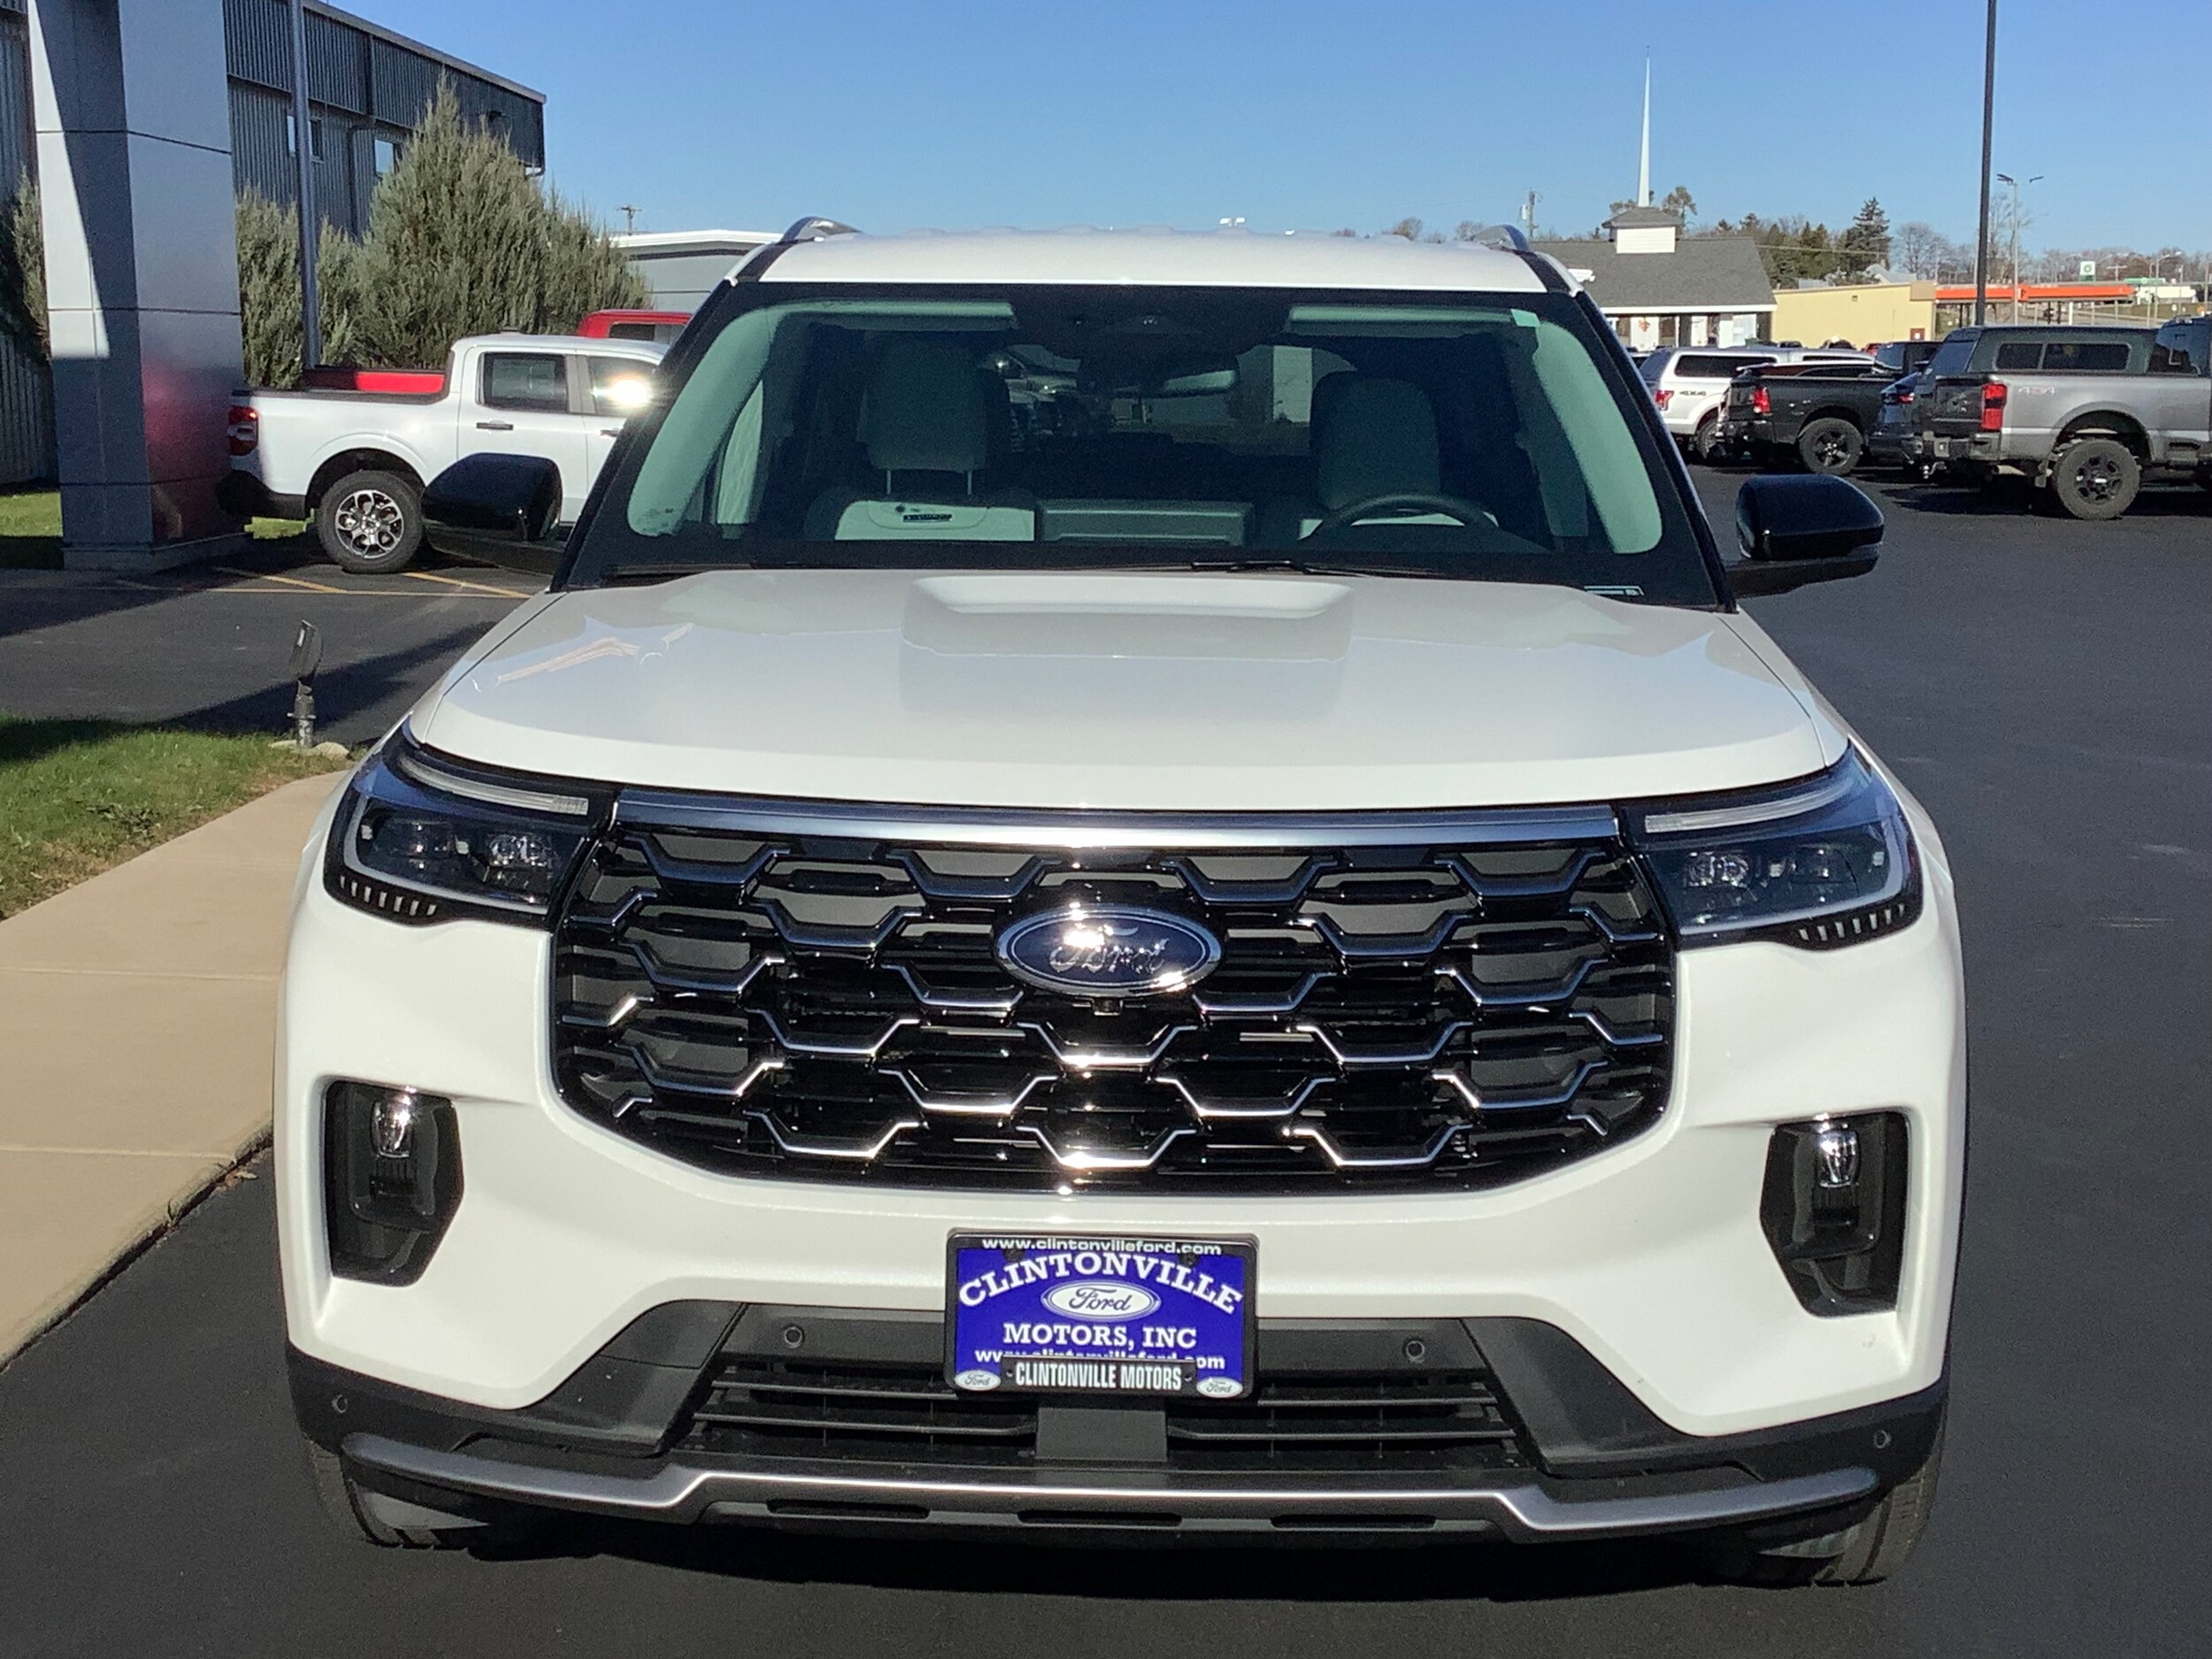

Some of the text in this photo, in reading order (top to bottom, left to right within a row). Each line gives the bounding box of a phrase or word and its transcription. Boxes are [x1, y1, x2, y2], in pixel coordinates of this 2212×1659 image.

[982, 1239, 1222, 1256] www.clintonvilleford.com
[959, 1251, 1243, 1315] CLINTONVILLE
[1069, 1286, 1133, 1312] Ford
[1002, 1322, 1197, 1351] MOTORS, INC
[964, 1373, 991, 1386] Ford
[1016, 1362, 1182, 1391] CLINTONVILLE MOTORS
[1206, 1380, 1233, 1394] Ford
